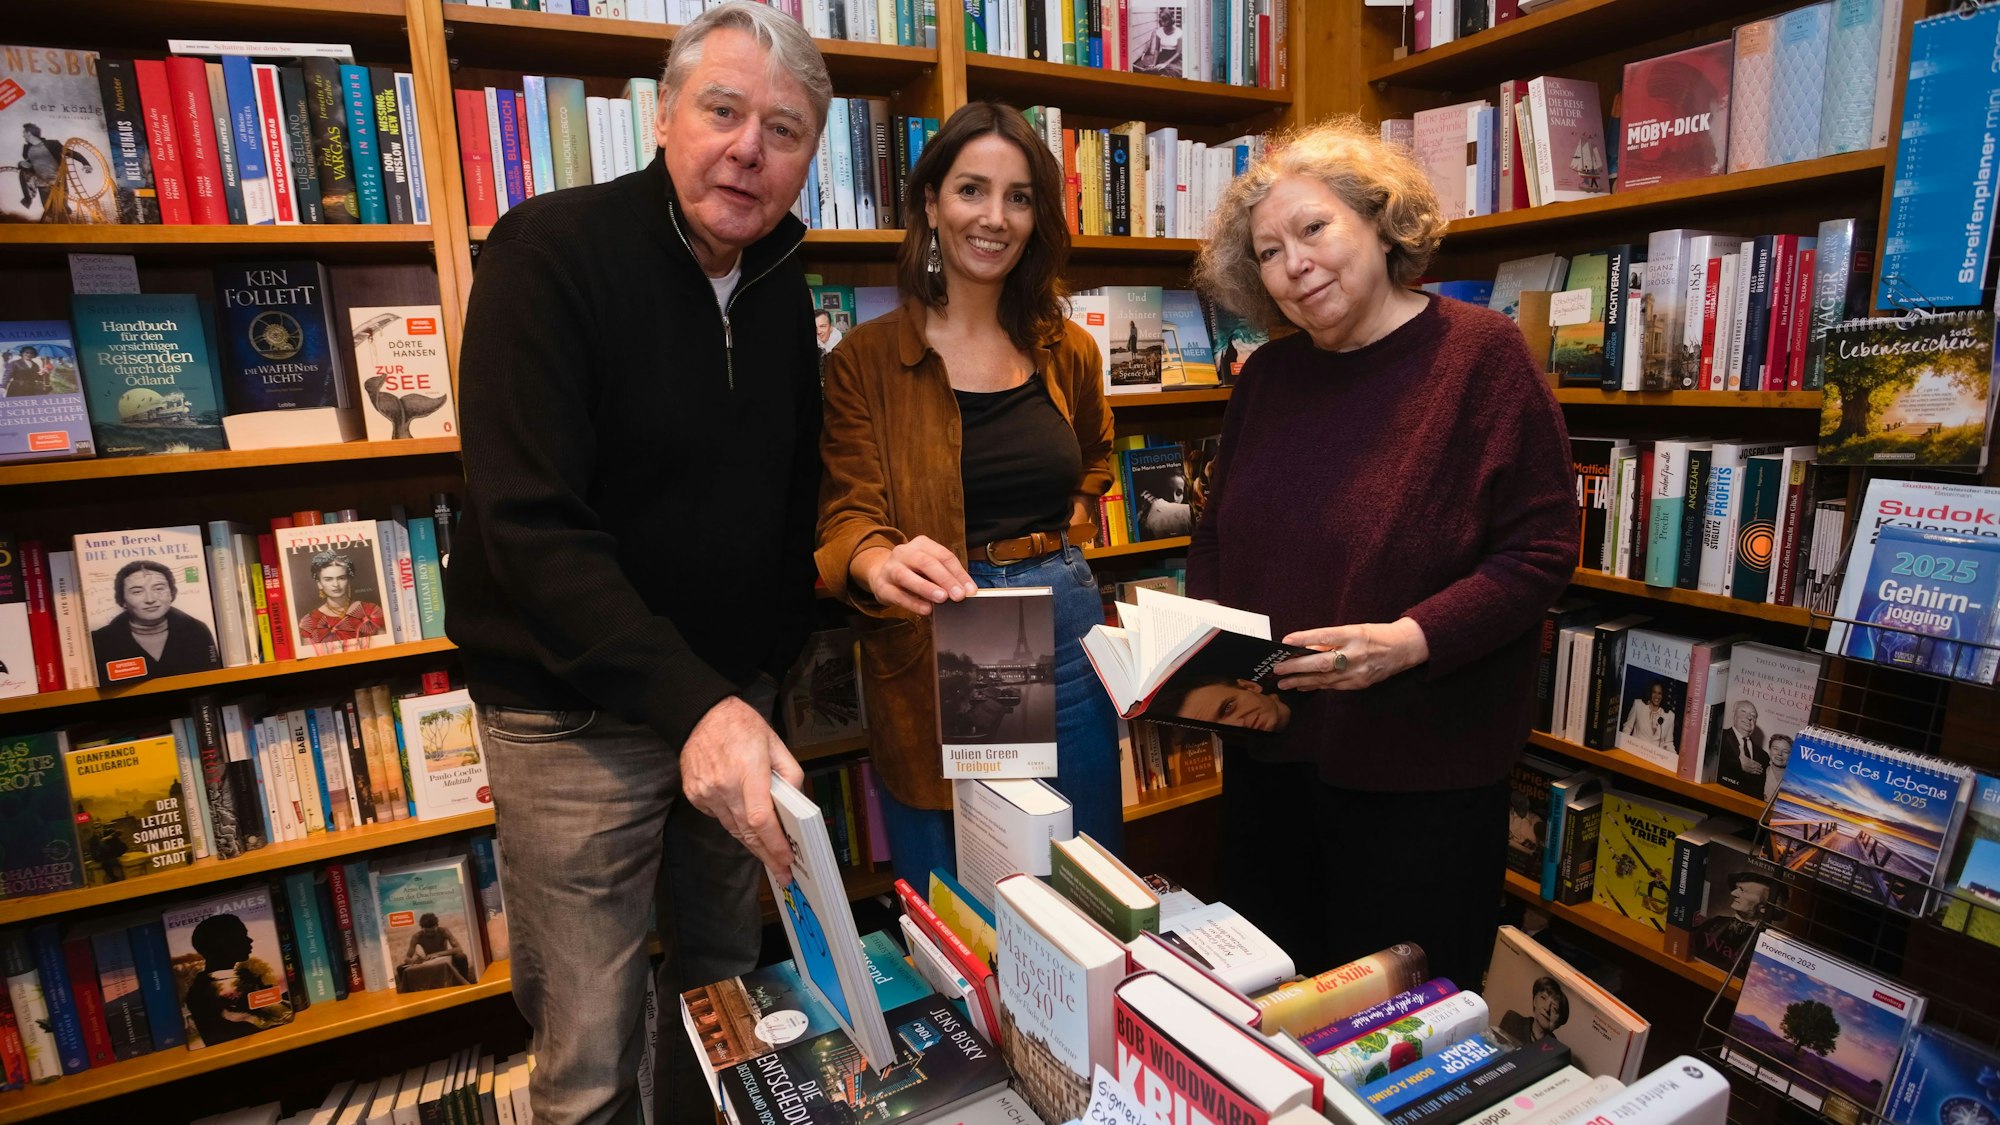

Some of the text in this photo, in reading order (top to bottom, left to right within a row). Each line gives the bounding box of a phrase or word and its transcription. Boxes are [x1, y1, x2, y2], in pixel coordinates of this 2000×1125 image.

[1546, 81, 1561, 90] JACK
[1547, 88, 1574, 98] LONDON
[31, 102, 103, 116] der könig
[375, 92, 388, 132] MISSING.
[1548, 98, 1585, 110] DIE REISE
[1549, 108, 1582, 118] MIT DER
[504, 101, 516, 161] BLUTBUCH
[1550, 118, 1577, 128] SNARK
[1627, 112, 1711, 145] MOBY-DICK
[118, 120, 141, 181] NELE NEUHAUS
[269, 118, 287, 195] DAS DOPPELTE GRAB
[322, 147, 332, 166] Fred
[328, 126, 341, 181] VARGAS
[384, 153, 394, 172] DON
[391, 142, 406, 183] WINSLOW
[523, 160, 533, 195] HORNBY
[1958, 132, 1996, 283] Streifenplaner
[246, 270, 288, 286] KEN
[1647, 264, 1674, 273] GLANZ
[1689, 263, 1703, 292] 1848
[1755, 249, 1768, 293] ÜBERSTANDEN?
[1609, 254, 1621, 325] MACHTVERFALL
[1645, 276, 1676, 286] GRÖSSE
[1800, 274, 1808, 302] TOLERANZ
[224, 286, 314, 307] FOLLETT
[1127, 292, 1147, 302] Und
[1817, 271, 1839, 339] WAGER
[1119, 310, 1156, 320] dahinter
[102, 320, 177, 332] Handbuch
[1139, 329, 1160, 338] Meer
[1950, 328, 1974, 337] 2025
[121, 332, 163, 341] für den
[388, 339, 423, 349] DÖRTE
[109, 342, 179, 352] vorsichtigen
[393, 348, 436, 358] HANSEN
[1183, 349, 1206, 357] MEER
[1839, 335, 1977, 360] Lebenszeichen
[96, 351, 194, 366] Reisenden
[115, 364, 182, 374] durch das
[245, 363, 318, 375] DIE WAFFEN DES
[375, 365, 404, 375] ZUR
[125, 374, 175, 386] Ödland
[263, 374, 304, 385] LICHTS
[385, 374, 431, 391] SEE
[0, 396, 81, 408] BESSER ALLEIN
[11, 405, 84, 417] SCHLECHTER
[0, 413, 86, 426] GESELLSCHAFT
[1130, 451, 1181, 465] Simenon
[1573, 463, 1610, 475] Mattioli
[1688, 459, 1700, 509] ANGEZÄHLT
[1713, 467, 1732, 517] PROFITS
[1878, 500, 2000, 526] Sudok
[1659, 512, 1669, 540] Precht
[1710, 520, 1721, 550] STIGLITZ
[85, 534, 162, 549] Anne Berest
[290, 533, 370, 555] FRIDA
[85, 543, 190, 561] DIE POSTKARTE
[400, 558, 415, 590] 1WTC
[1892, 552, 1979, 584] 2025
[419, 555, 433, 624] WILLIAM BOYD
[1878, 579, 1982, 613] Gehirn-
[1885, 603, 1953, 630] jogging
[1631, 637, 1692, 662] KAMALA
[1253, 648, 1284, 673] ALEXEJ
[1632, 649, 1688, 674] HARRIS
[1756, 657, 1805, 674] THILO WYDRA
[1735, 675, 1814, 701] ALMA & ALFRE
[1741, 668, 1816, 691] EINE LIEBE FÜRS LEBEN
[1743, 687, 1811, 711] HITCHCOCK
[297, 725, 306, 754] BABEL
[75, 746, 136, 765] GIANFRANCO
[949, 747, 1019, 761] Julien Green
[77, 757, 139, 776] CALLIGARICH
[429, 766, 482, 784] Paulo Coelho
[955, 760, 1002, 774] Treibgut
[1800, 745, 1947, 800] Worte des Lebens
[443, 776, 473, 788] Maktub
[156, 797, 178, 811] DER
[1893, 790, 1927, 809] 2025
[141, 810, 181, 829] LETZTE
[1623, 814, 1677, 840] WALTER
[132, 824, 183, 844] SOMMER
[1630, 827, 1668, 848] TRIER
[146, 838, 185, 855] IN DER
[152, 851, 187, 868] STADT
[1748, 858, 1775, 872] MARTIN
[213, 895, 266, 914] JAMES
[331, 870, 348, 924] ARNO GEIGER
[1015, 927, 1075, 984] WITTSTOCK
[1761, 941, 1796, 962] Provence
[1796, 957, 1816, 972] 2025
[1000, 926, 1075, 1013] Marseille
[1316, 965, 1374, 993] der Stille
[1016, 965, 1053, 1020] 1940
[930, 1008, 987, 1061] JENS BISKY
[1438, 1039, 1481, 1061] NOAH
[1442, 1043, 1499, 1074] TREVOR
[1117, 1007, 1256, 1125] BOB WOODWARD
[1407, 1067, 1436, 1084] BORN
[736, 1063, 766, 1111] DEUTSCHLAND
[797, 1080, 823, 1101] DIE
[1367, 1084, 1401, 1104] CRIME
[1611, 1081, 1680, 1120] Manfred Lütz
